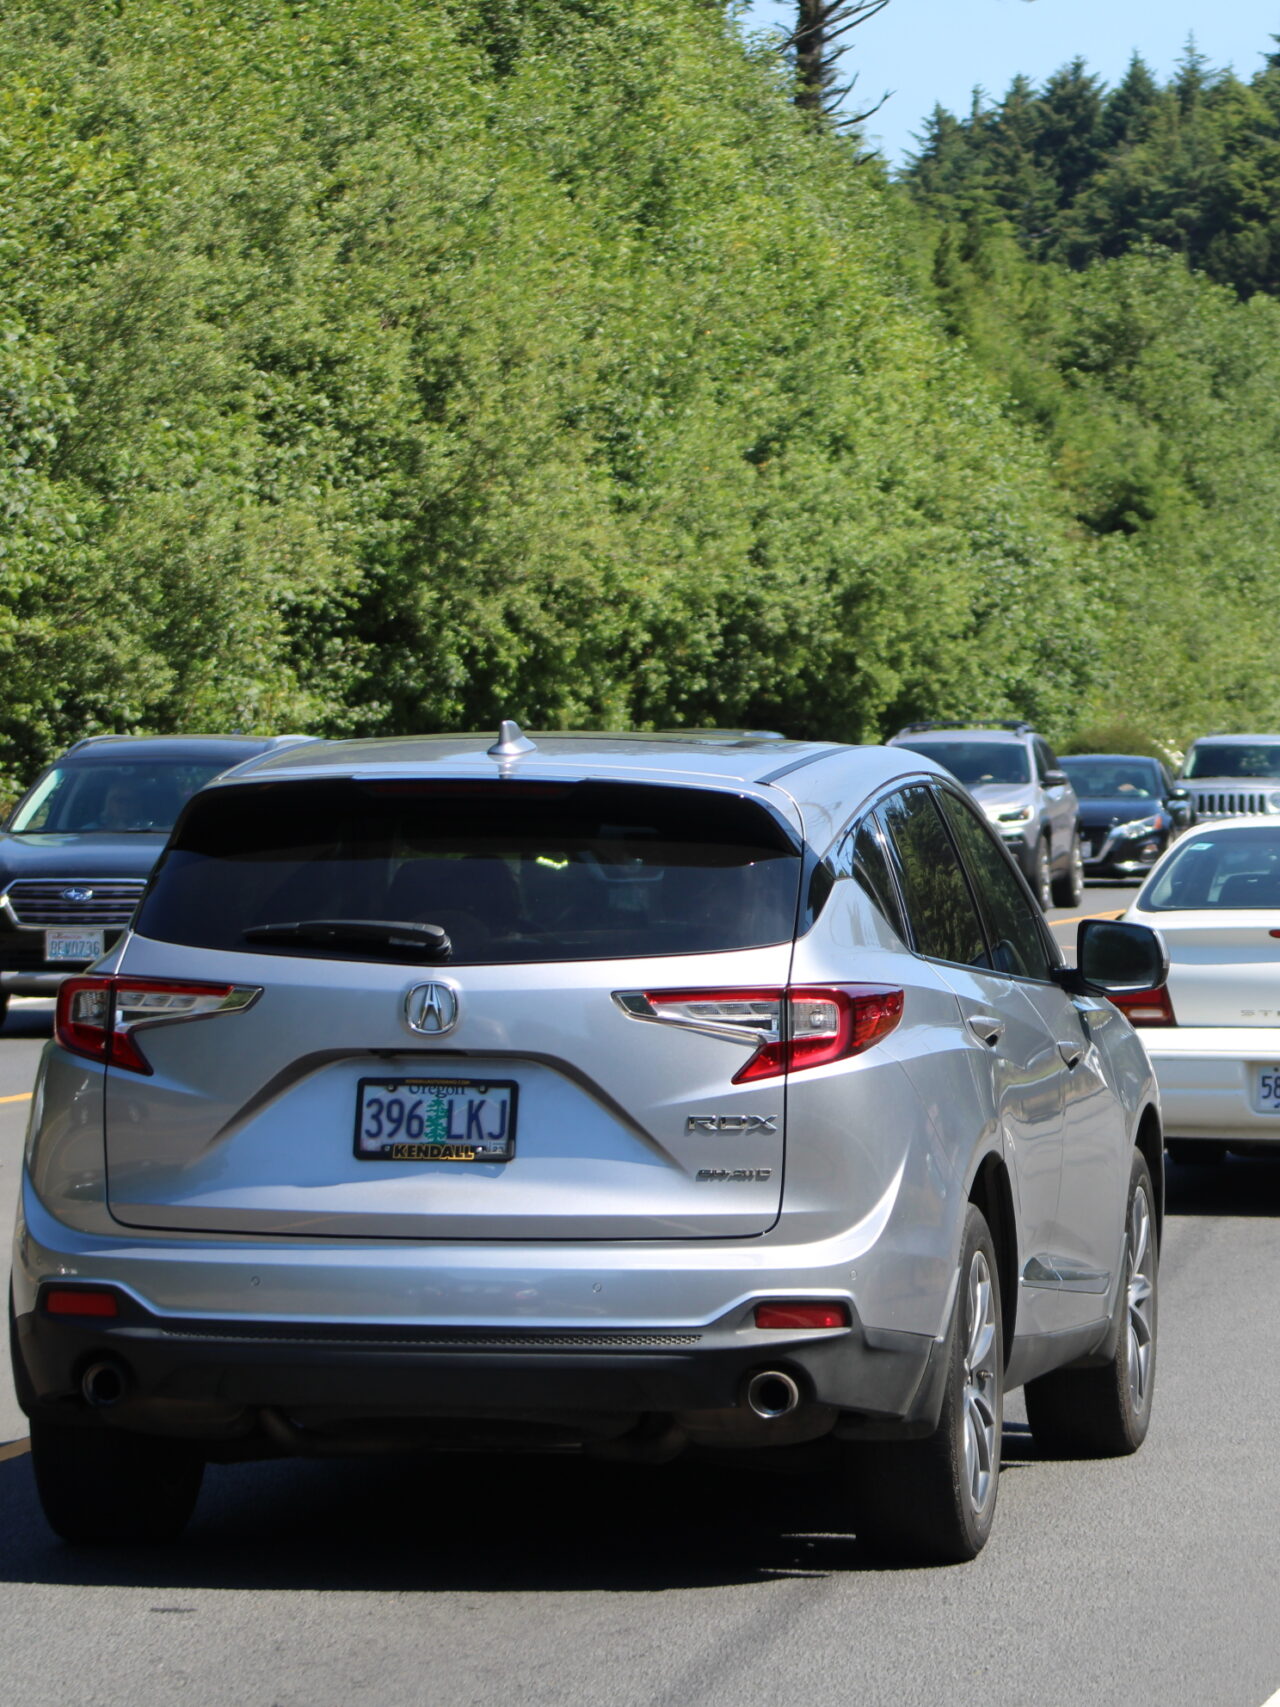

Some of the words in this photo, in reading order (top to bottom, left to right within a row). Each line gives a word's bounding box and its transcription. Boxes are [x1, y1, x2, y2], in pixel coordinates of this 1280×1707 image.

[408, 1085, 466, 1099] Oregon
[365, 1098, 425, 1139] 396
[446, 1098, 507, 1140] LKJ
[687, 1114, 778, 1131] RDX
[392, 1143, 475, 1160] KENDALL
